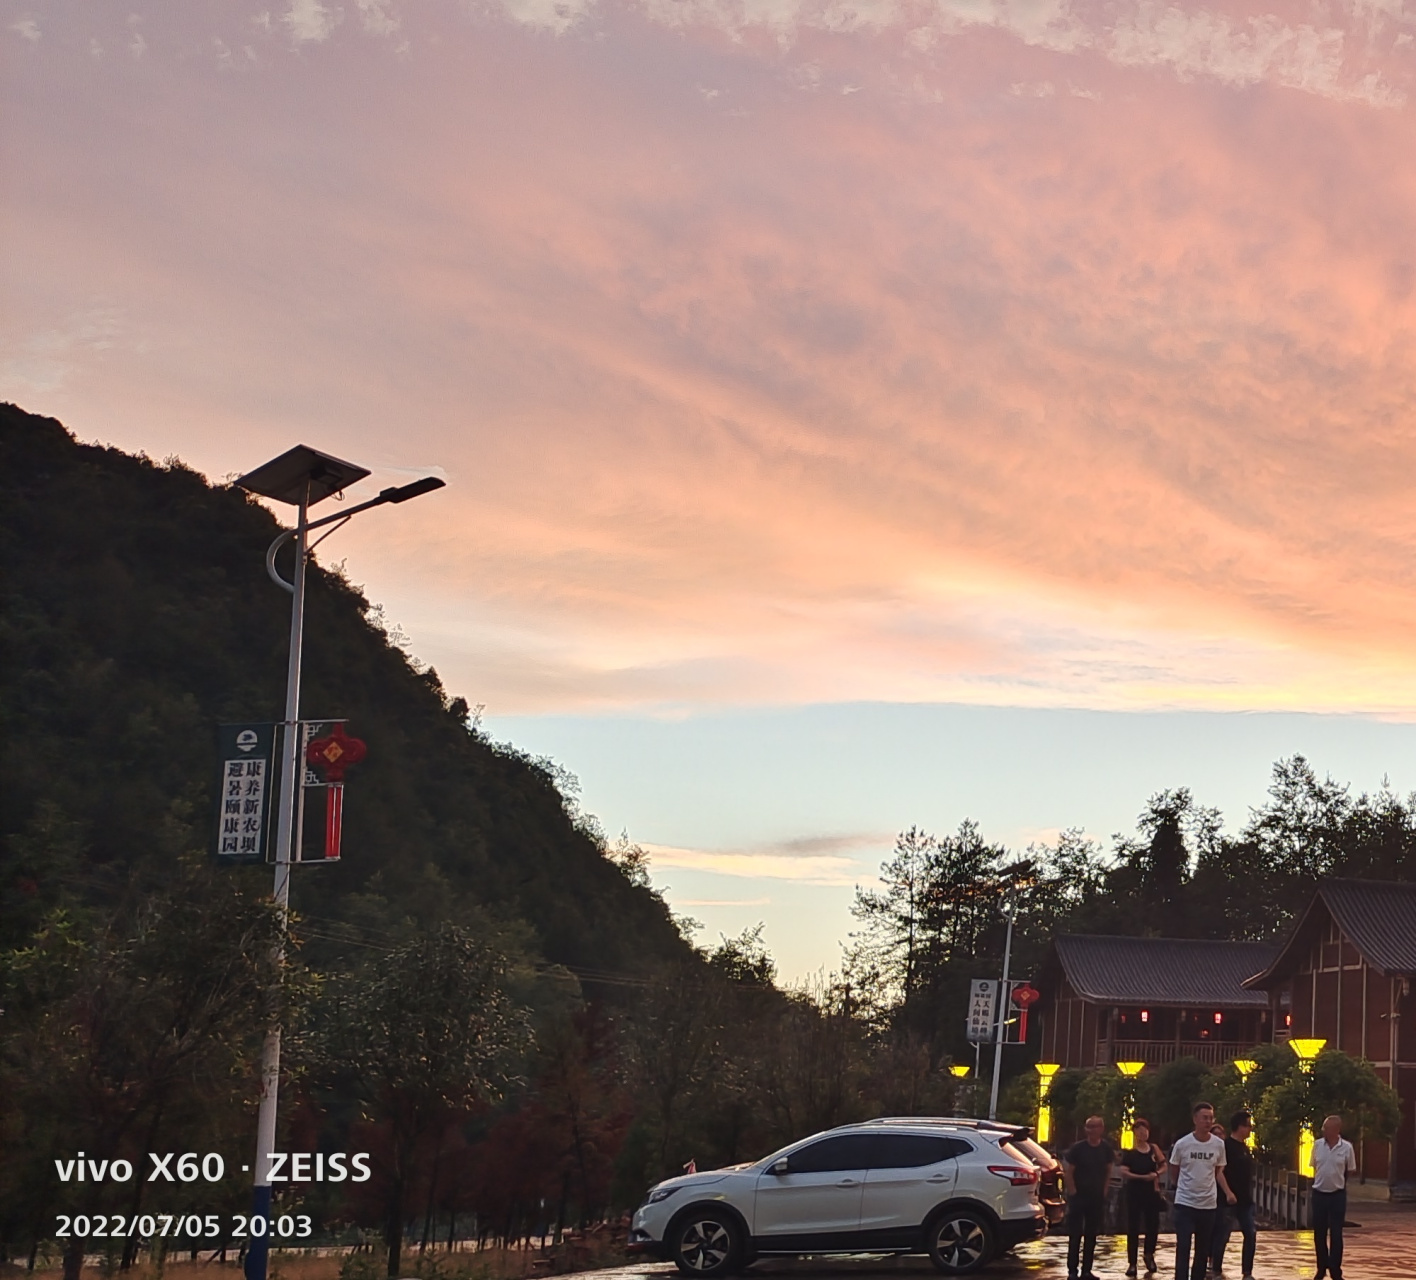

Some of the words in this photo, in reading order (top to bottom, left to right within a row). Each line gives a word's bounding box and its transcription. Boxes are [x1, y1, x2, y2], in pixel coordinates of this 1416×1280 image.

[222, 762, 243, 852] 避暑颐康园
[241, 761, 261, 852] 康养新农坝
